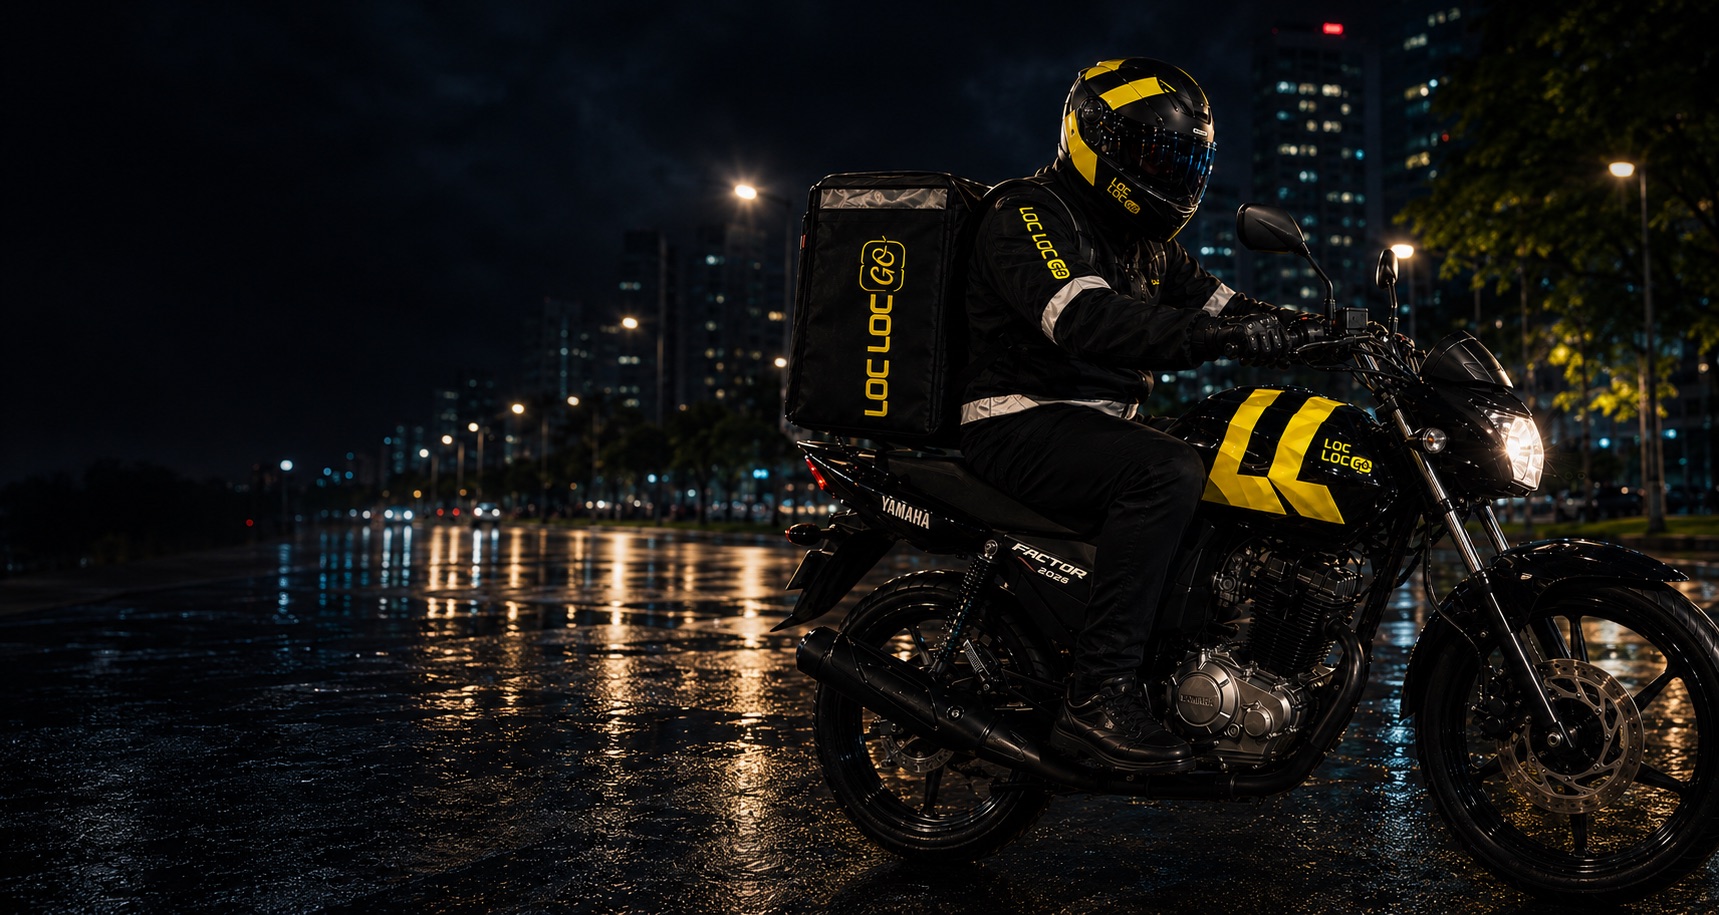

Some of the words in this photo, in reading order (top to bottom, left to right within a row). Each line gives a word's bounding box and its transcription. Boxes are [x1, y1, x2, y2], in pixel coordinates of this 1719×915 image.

[1106, 184, 1127, 203] LOC
[1111, 177, 1132, 196] LOC
[1019, 207, 1043, 231] LOC
[1032, 234, 1058, 260] LOC
[867, 293, 894, 353] LOC
[864, 358, 889, 417] LOC
[1321, 449, 1350, 466] LOC
[1324, 438, 1351, 454] LOC
[881, 495, 930, 530] YAMAHA
[1012, 542, 1088, 580] FACTOR
